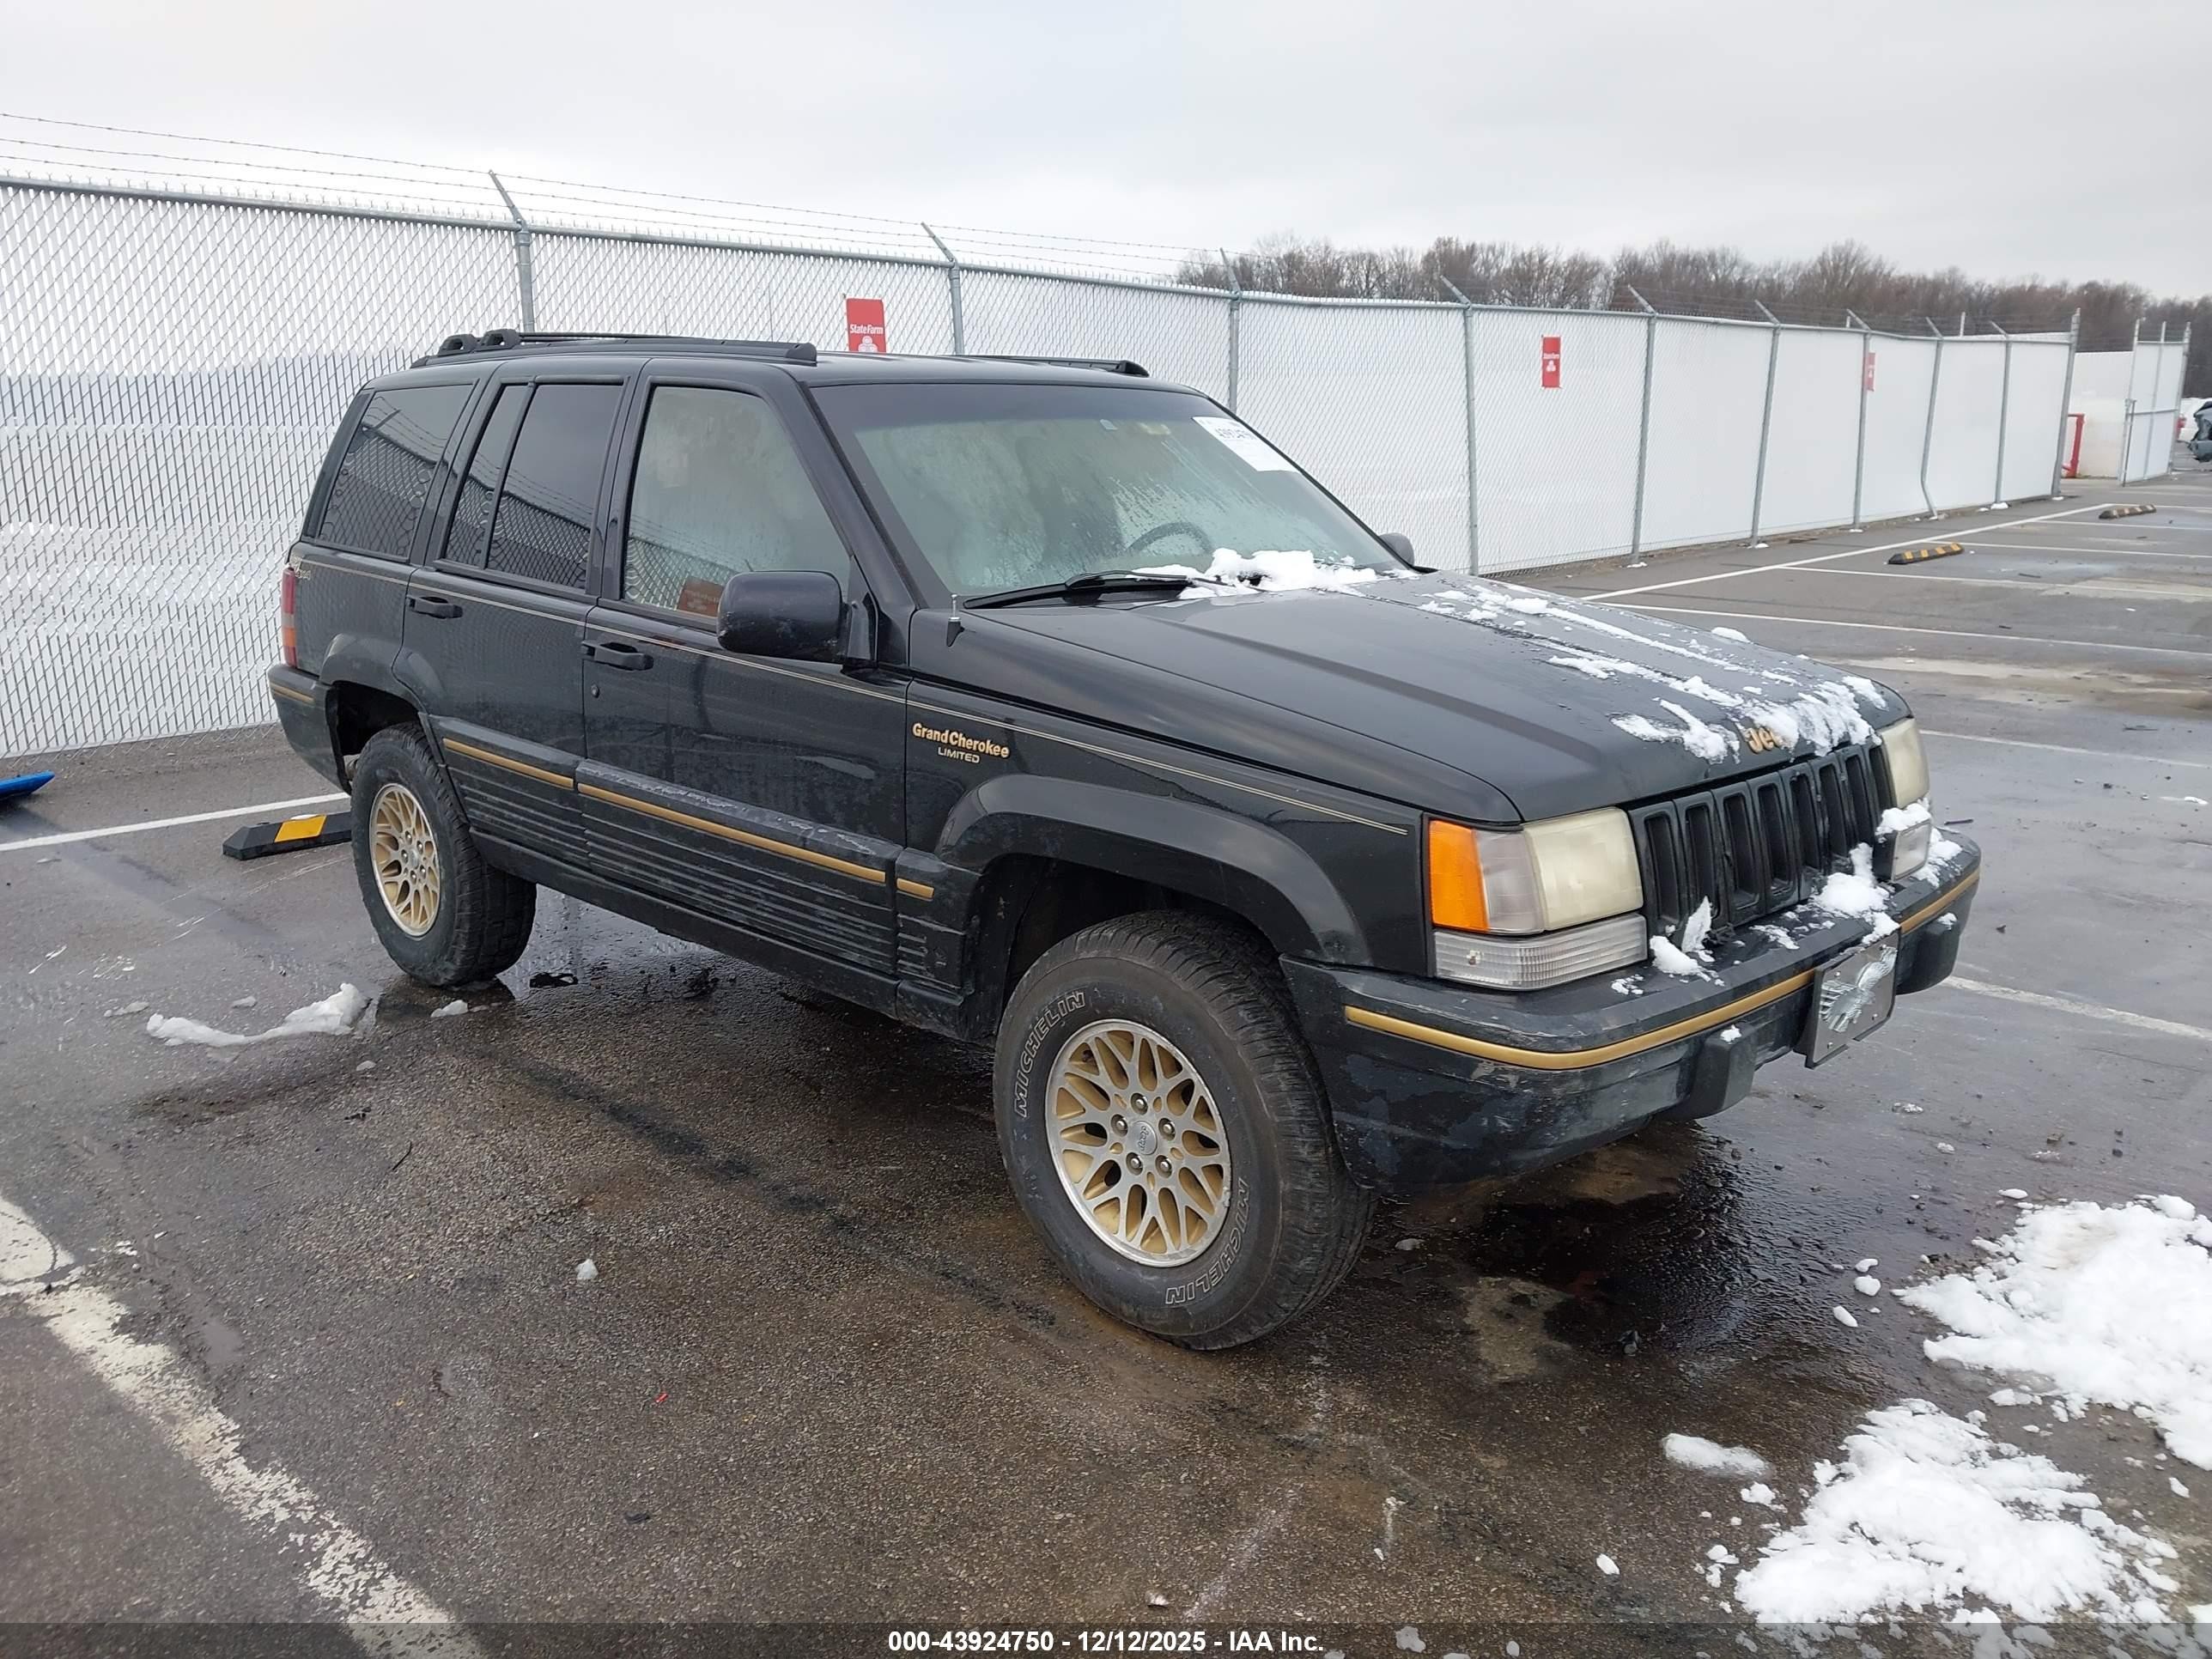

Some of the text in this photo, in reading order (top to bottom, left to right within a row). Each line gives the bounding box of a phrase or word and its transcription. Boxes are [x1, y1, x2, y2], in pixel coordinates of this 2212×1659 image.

[938, 747, 980, 763] LIMITED
[1014, 992, 1085, 1118] MICHELIN
[1165, 1176, 1249, 1304] MICHELIN
